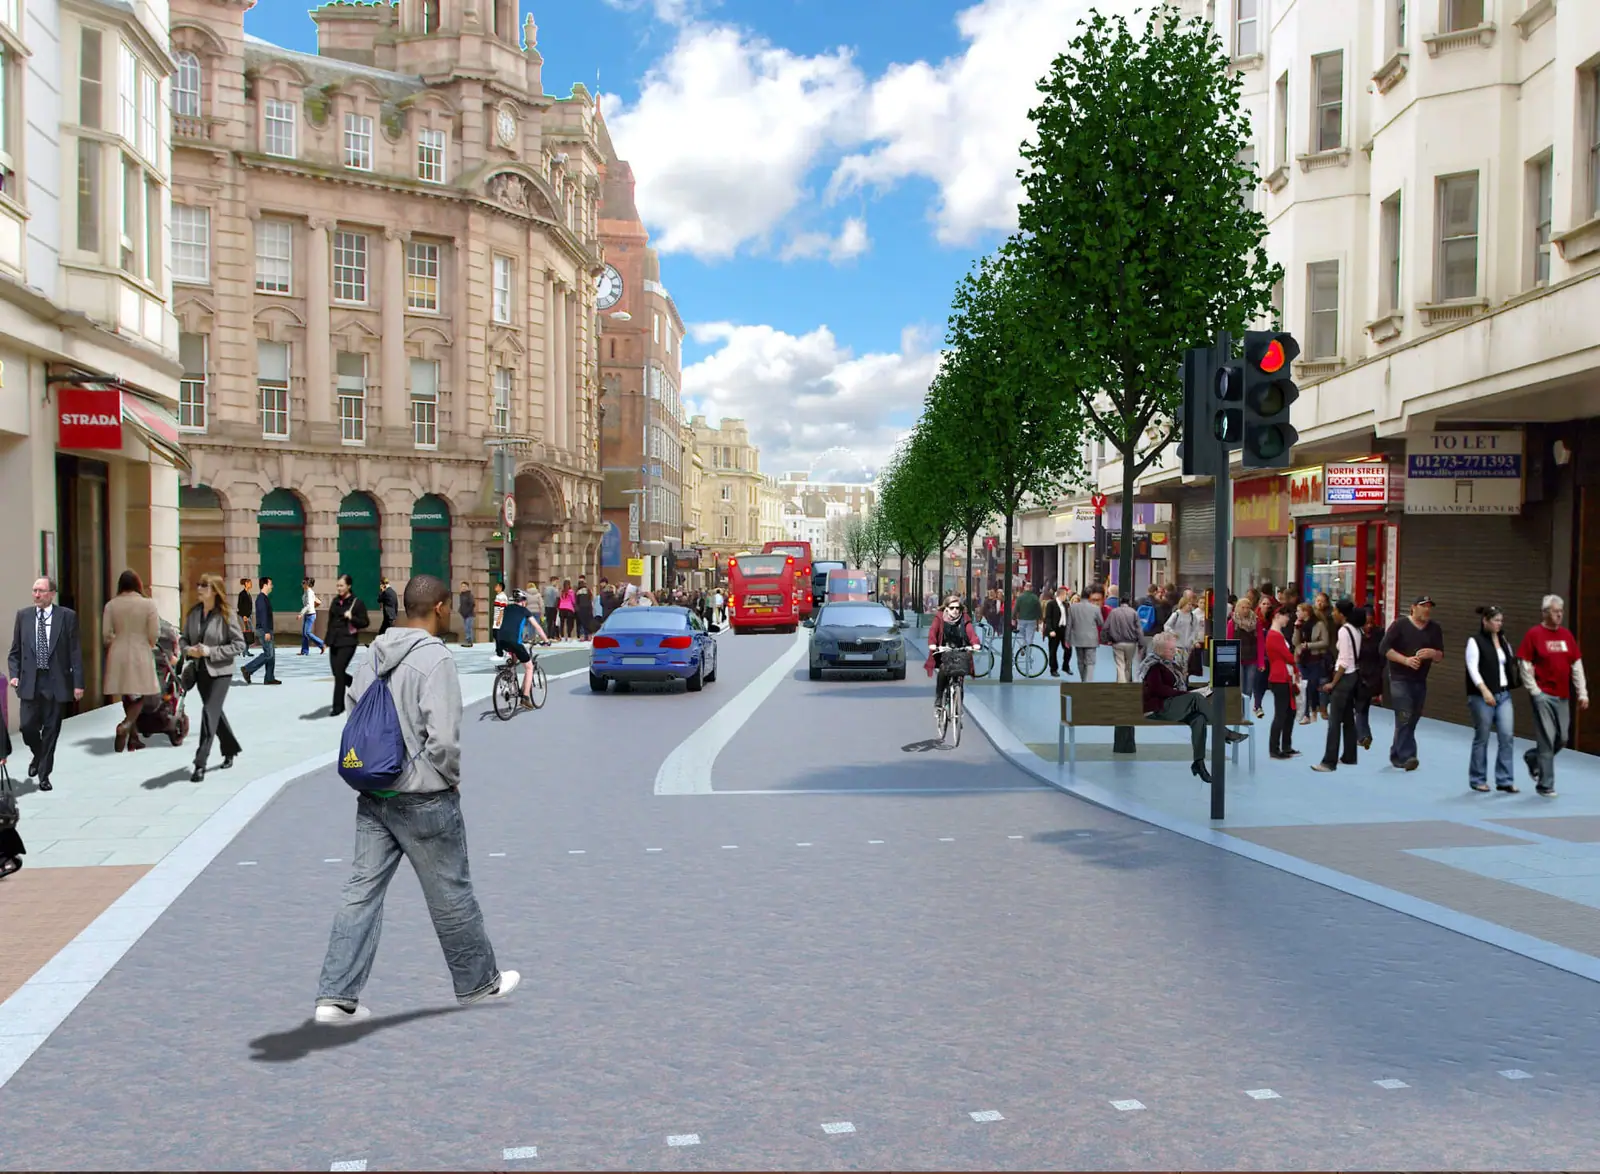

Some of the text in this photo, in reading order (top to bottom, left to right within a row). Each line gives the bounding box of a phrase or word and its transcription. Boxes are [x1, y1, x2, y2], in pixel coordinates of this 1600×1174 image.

[61, 413, 119, 426] STRADA
[1430, 435, 1500, 449] TO LET
[1415, 455, 1515, 468] 01273-771393
[1329, 477, 1383, 485] FOOD & WINE
[1356, 490, 1384, 498] LOTTERY
[1407, 505, 1520, 513] ELLIS AND PARTNERS
